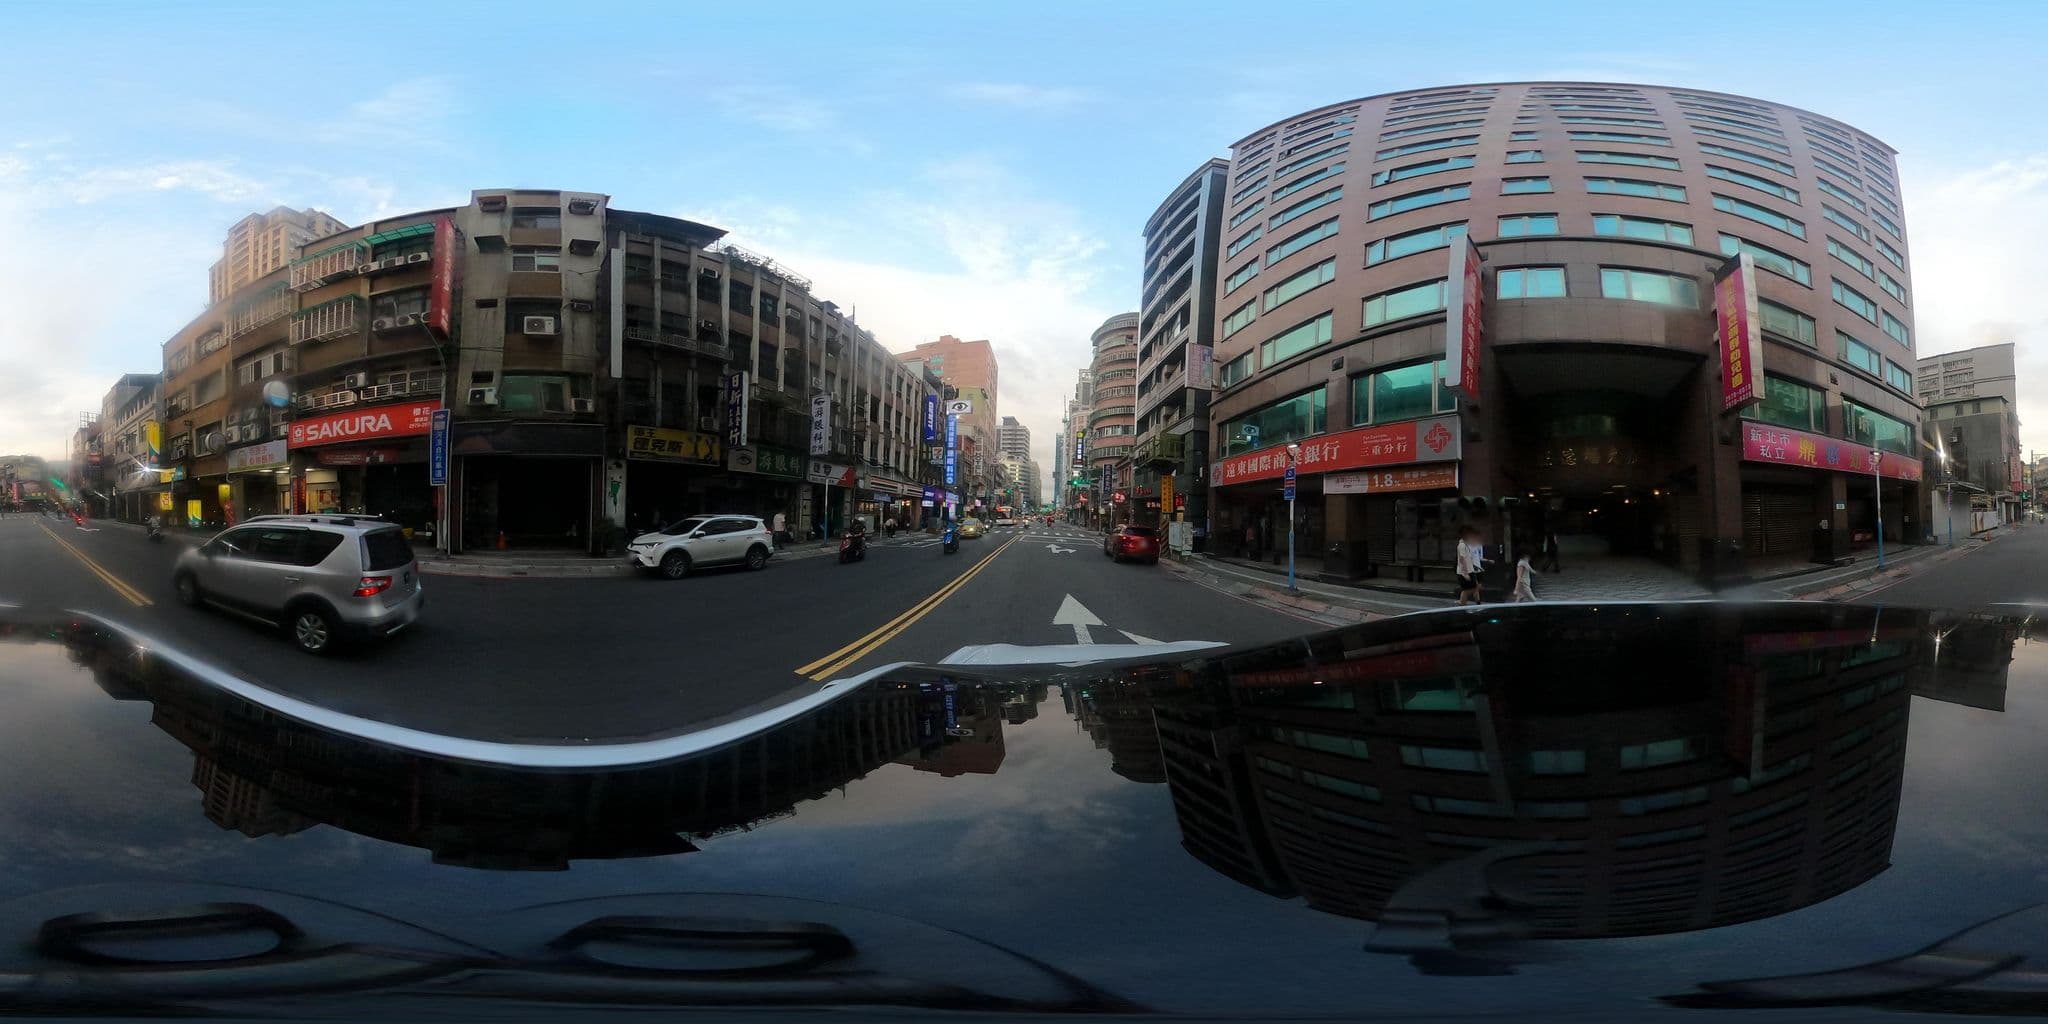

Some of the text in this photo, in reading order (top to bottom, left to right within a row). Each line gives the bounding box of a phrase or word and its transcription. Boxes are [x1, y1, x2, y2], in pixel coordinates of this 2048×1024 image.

[306, 414, 392, 441] SAKURA
[1750, 427, 1791, 446] 新北市
[1226, 439, 1341, 478] 遠東國際商業銀行
[1360, 442, 1408, 457] 三重分行
[1759, 444, 1786, 460] 私立
